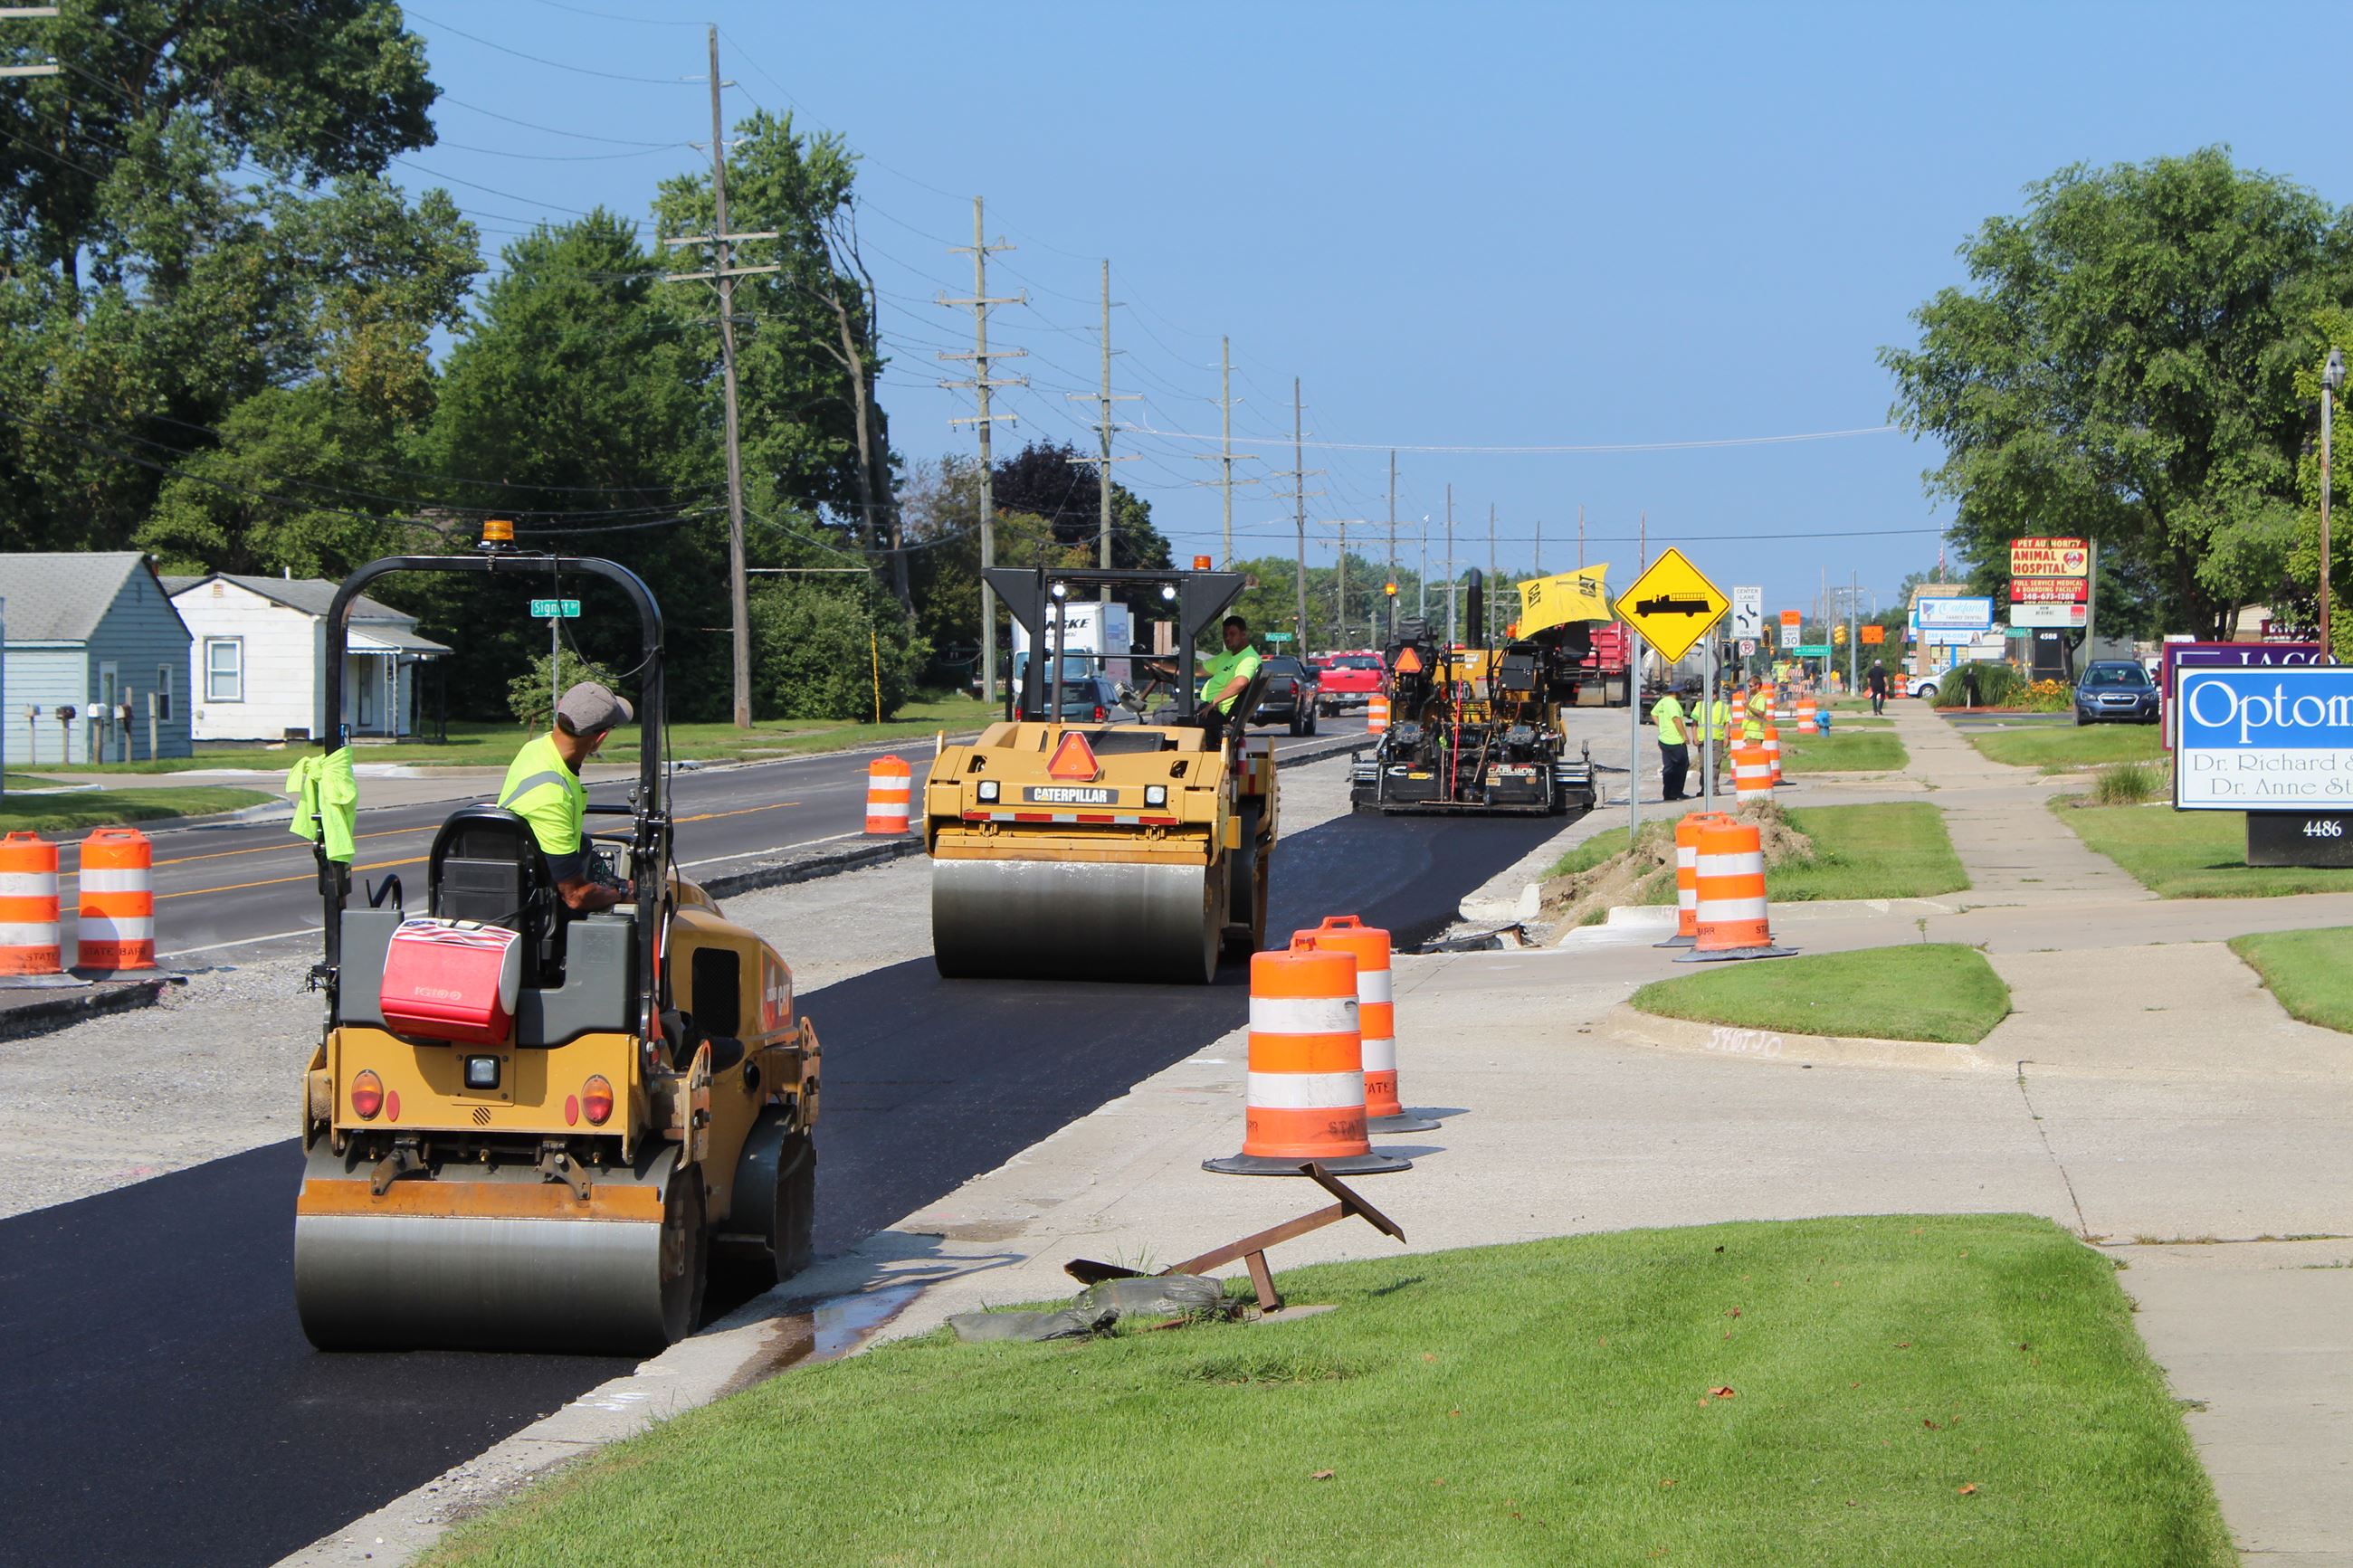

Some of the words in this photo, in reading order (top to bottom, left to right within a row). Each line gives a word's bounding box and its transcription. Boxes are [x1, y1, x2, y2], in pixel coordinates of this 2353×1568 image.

[2017, 539, 2033, 548] PET
[2034, 539, 2082, 548] AUHORITY
[2013, 550, 2057, 561] ANIMAL
[2013, 563, 2068, 575] HOSPITAL
[1578, 575, 1596, 598] CAT
[2014, 579, 2029, 587] FULL
[2030, 579, 2055, 587] SERVICE
[2056, 579, 2084, 587] MEDICAL
[1528, 583, 1541, 610] CAT
[1784, 636, 1798, 645] 30
[2193, 754, 2228, 772] Dr.
[2237, 753, 2336, 772] Richard
[2211, 777, 2246, 795] Dr.
[2254, 777, 2317, 795] Anne
[1034, 787, 1108, 803] CATERPILLAR
[2302, 820, 2342, 838] 4486
[26, 952, 57, 962] STATE
[83, 947, 115, 956] STATE
[119, 947, 147, 956] BARR
[1364, 1081, 1390, 1095] ATE
